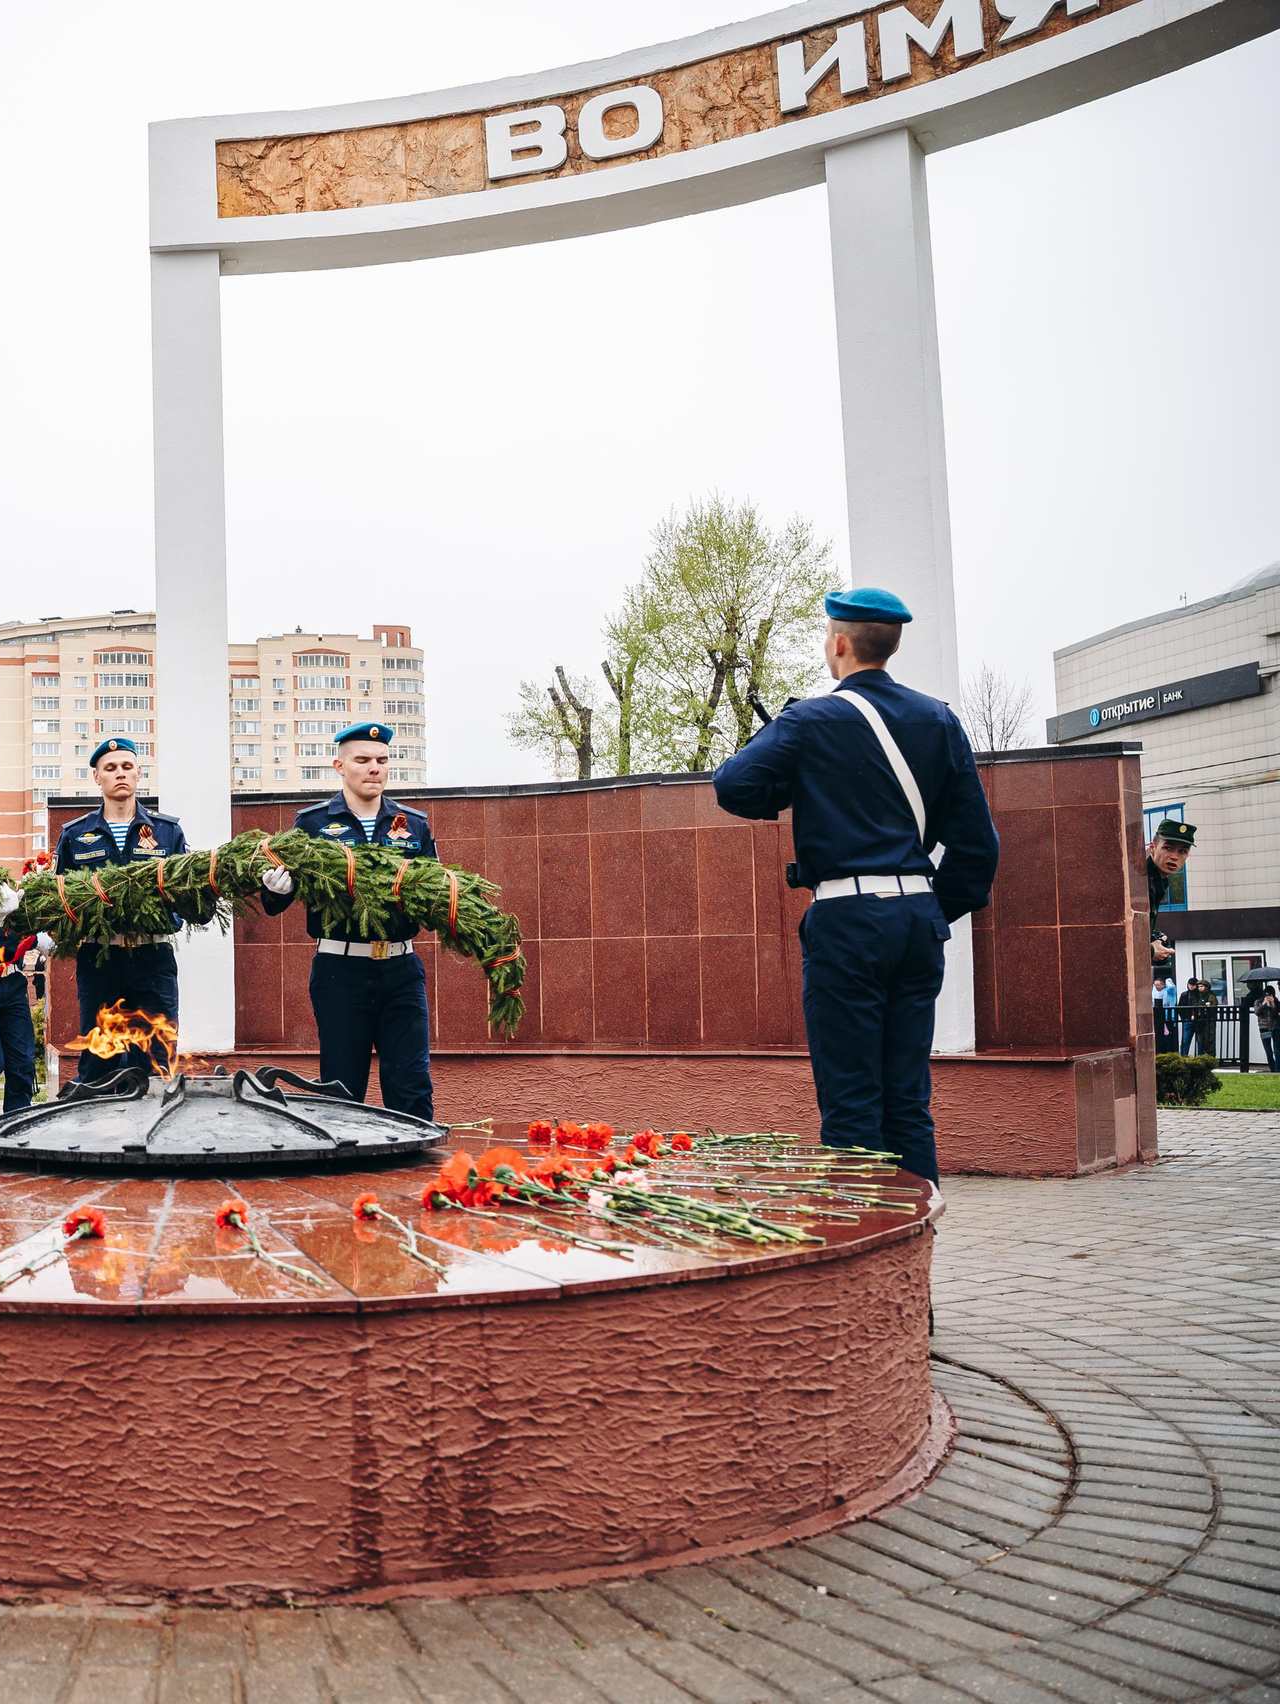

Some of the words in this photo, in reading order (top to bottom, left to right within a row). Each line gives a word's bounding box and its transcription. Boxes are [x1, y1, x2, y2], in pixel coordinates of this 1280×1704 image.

[485, 85, 663, 180] ВО
[1101, 696, 1155, 720] открытие
[1163, 690, 1183, 703] БАНК
